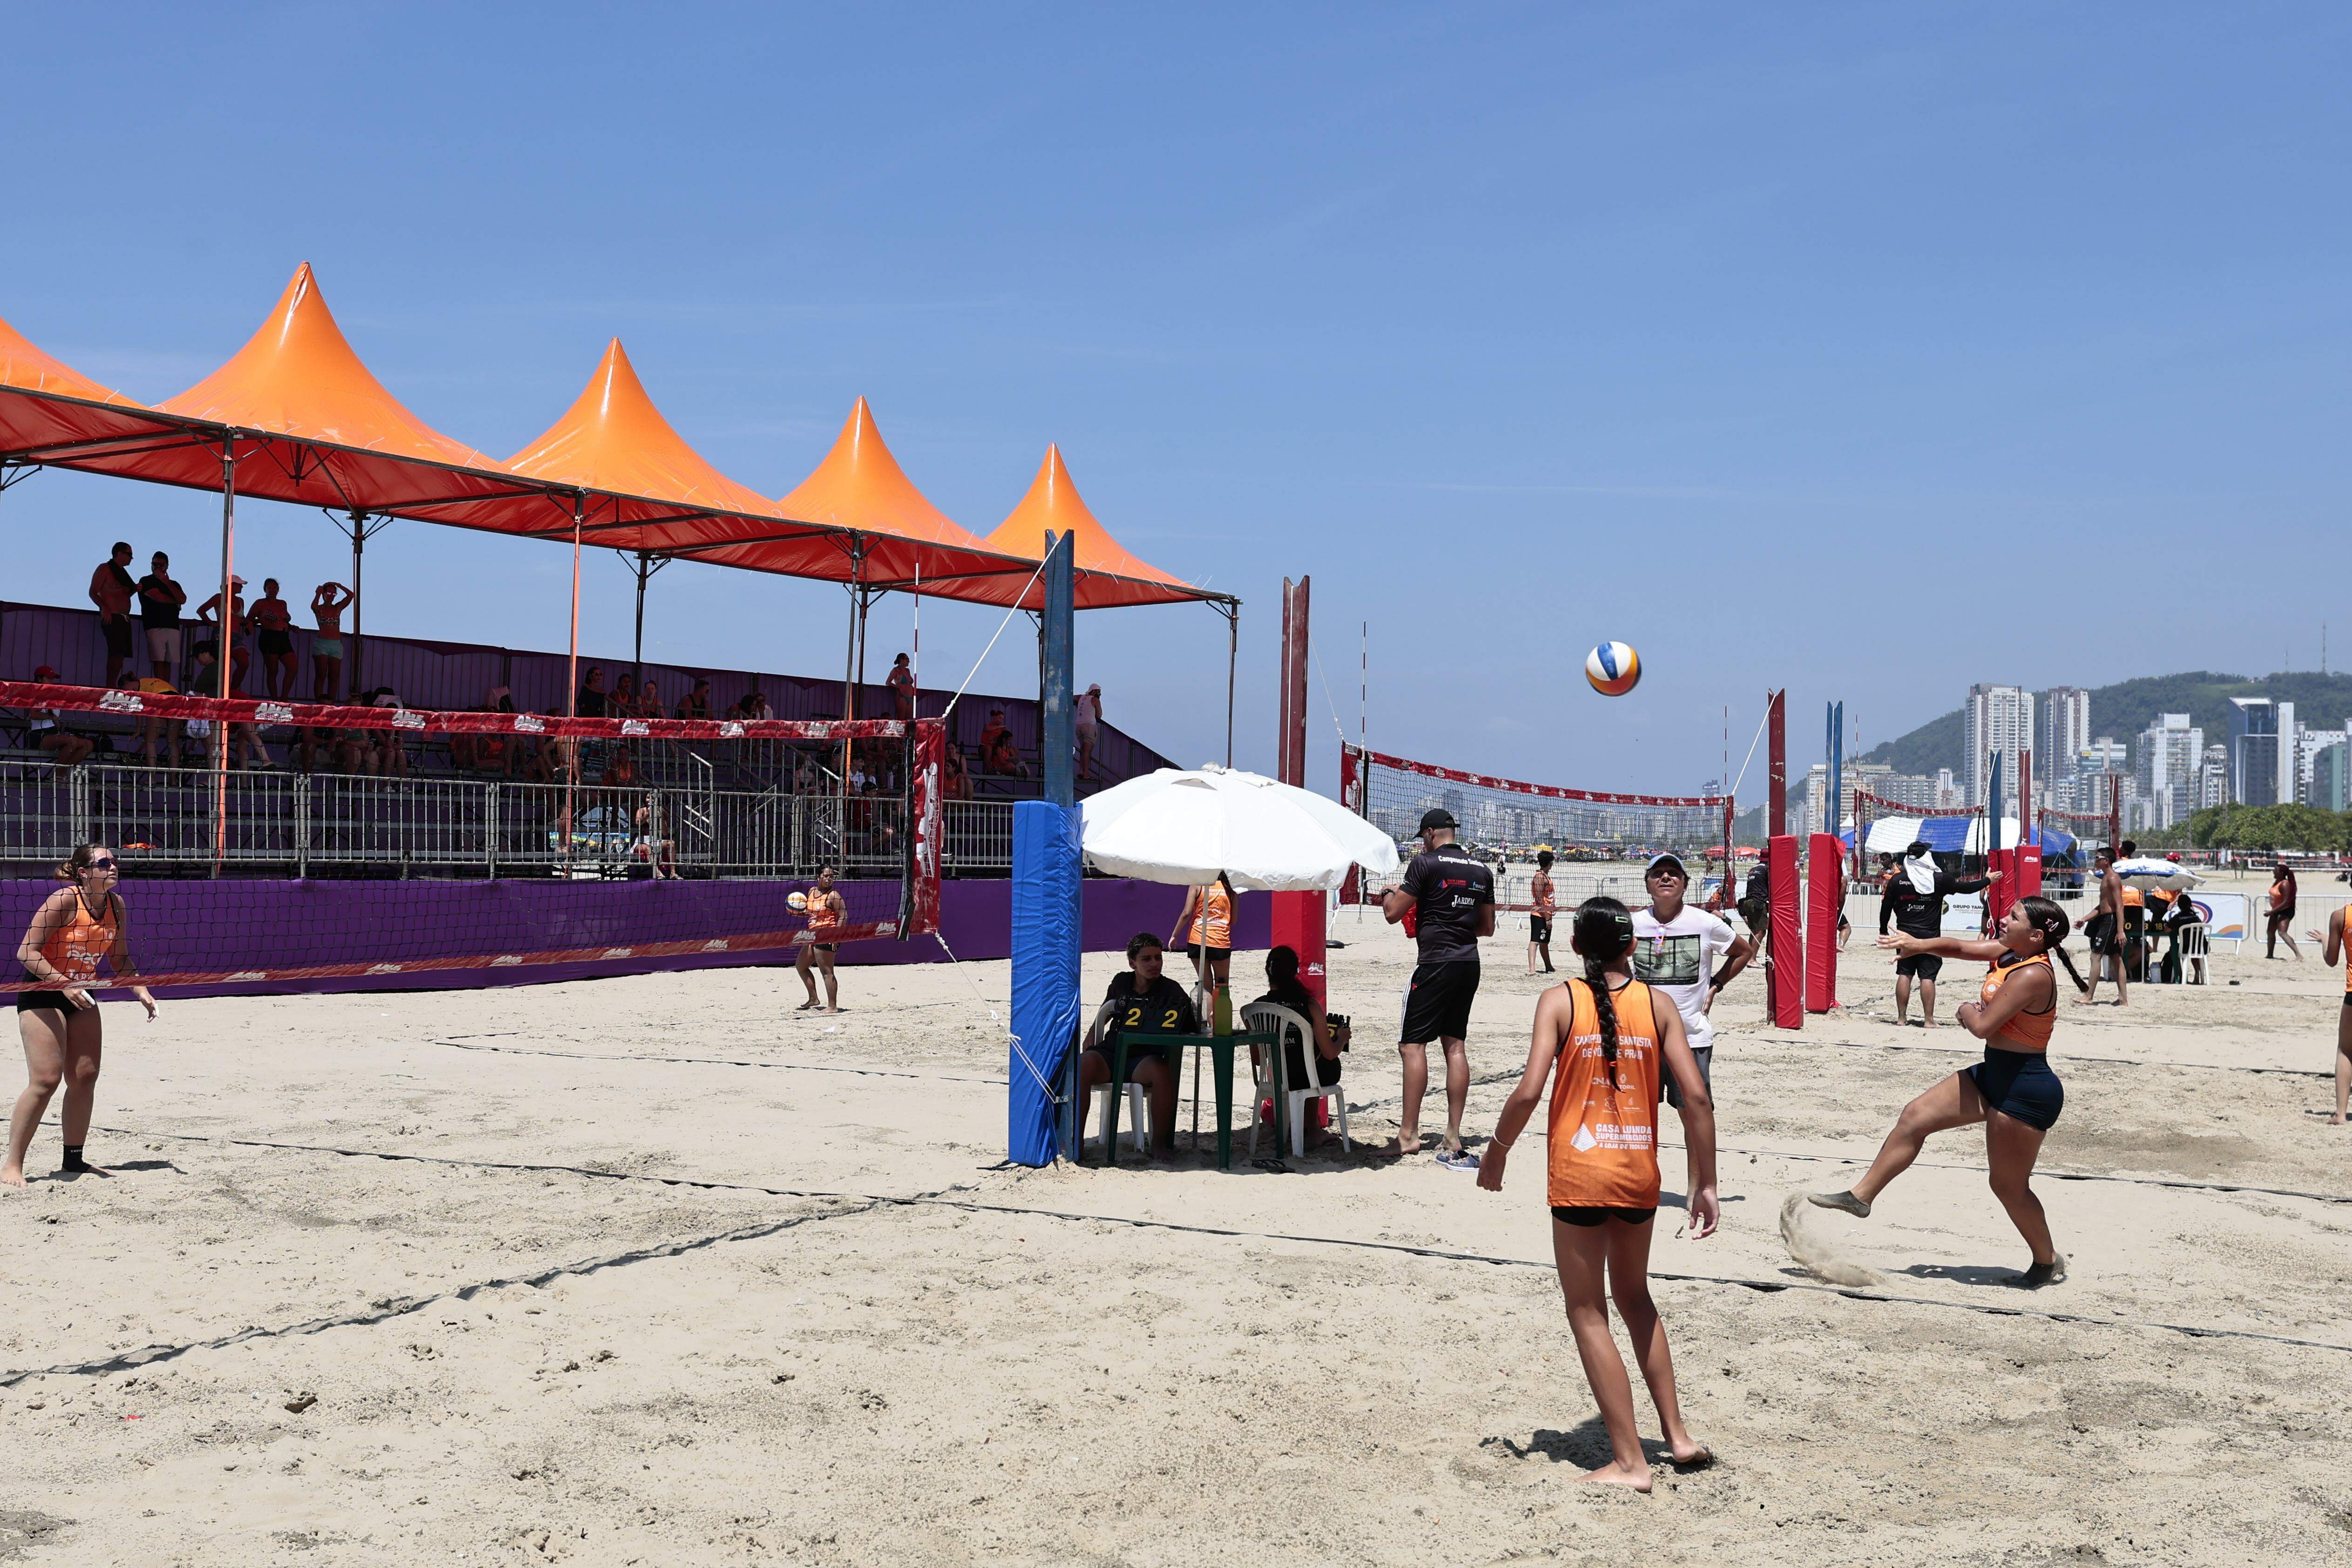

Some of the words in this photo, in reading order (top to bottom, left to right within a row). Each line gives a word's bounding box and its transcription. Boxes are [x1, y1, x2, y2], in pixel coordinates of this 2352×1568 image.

[1438, 855, 1468, 865] Campeonato
[1452, 895, 1475, 907] JARDIM
[1125, 1008, 1141, 1025] 2
[1162, 1010, 1178, 1027] 2
[1619, 1035, 1652, 1048] SANTISTA
[1582, 1048, 1592, 1058] DE
[1595, 1123, 1620, 1133] CASA
